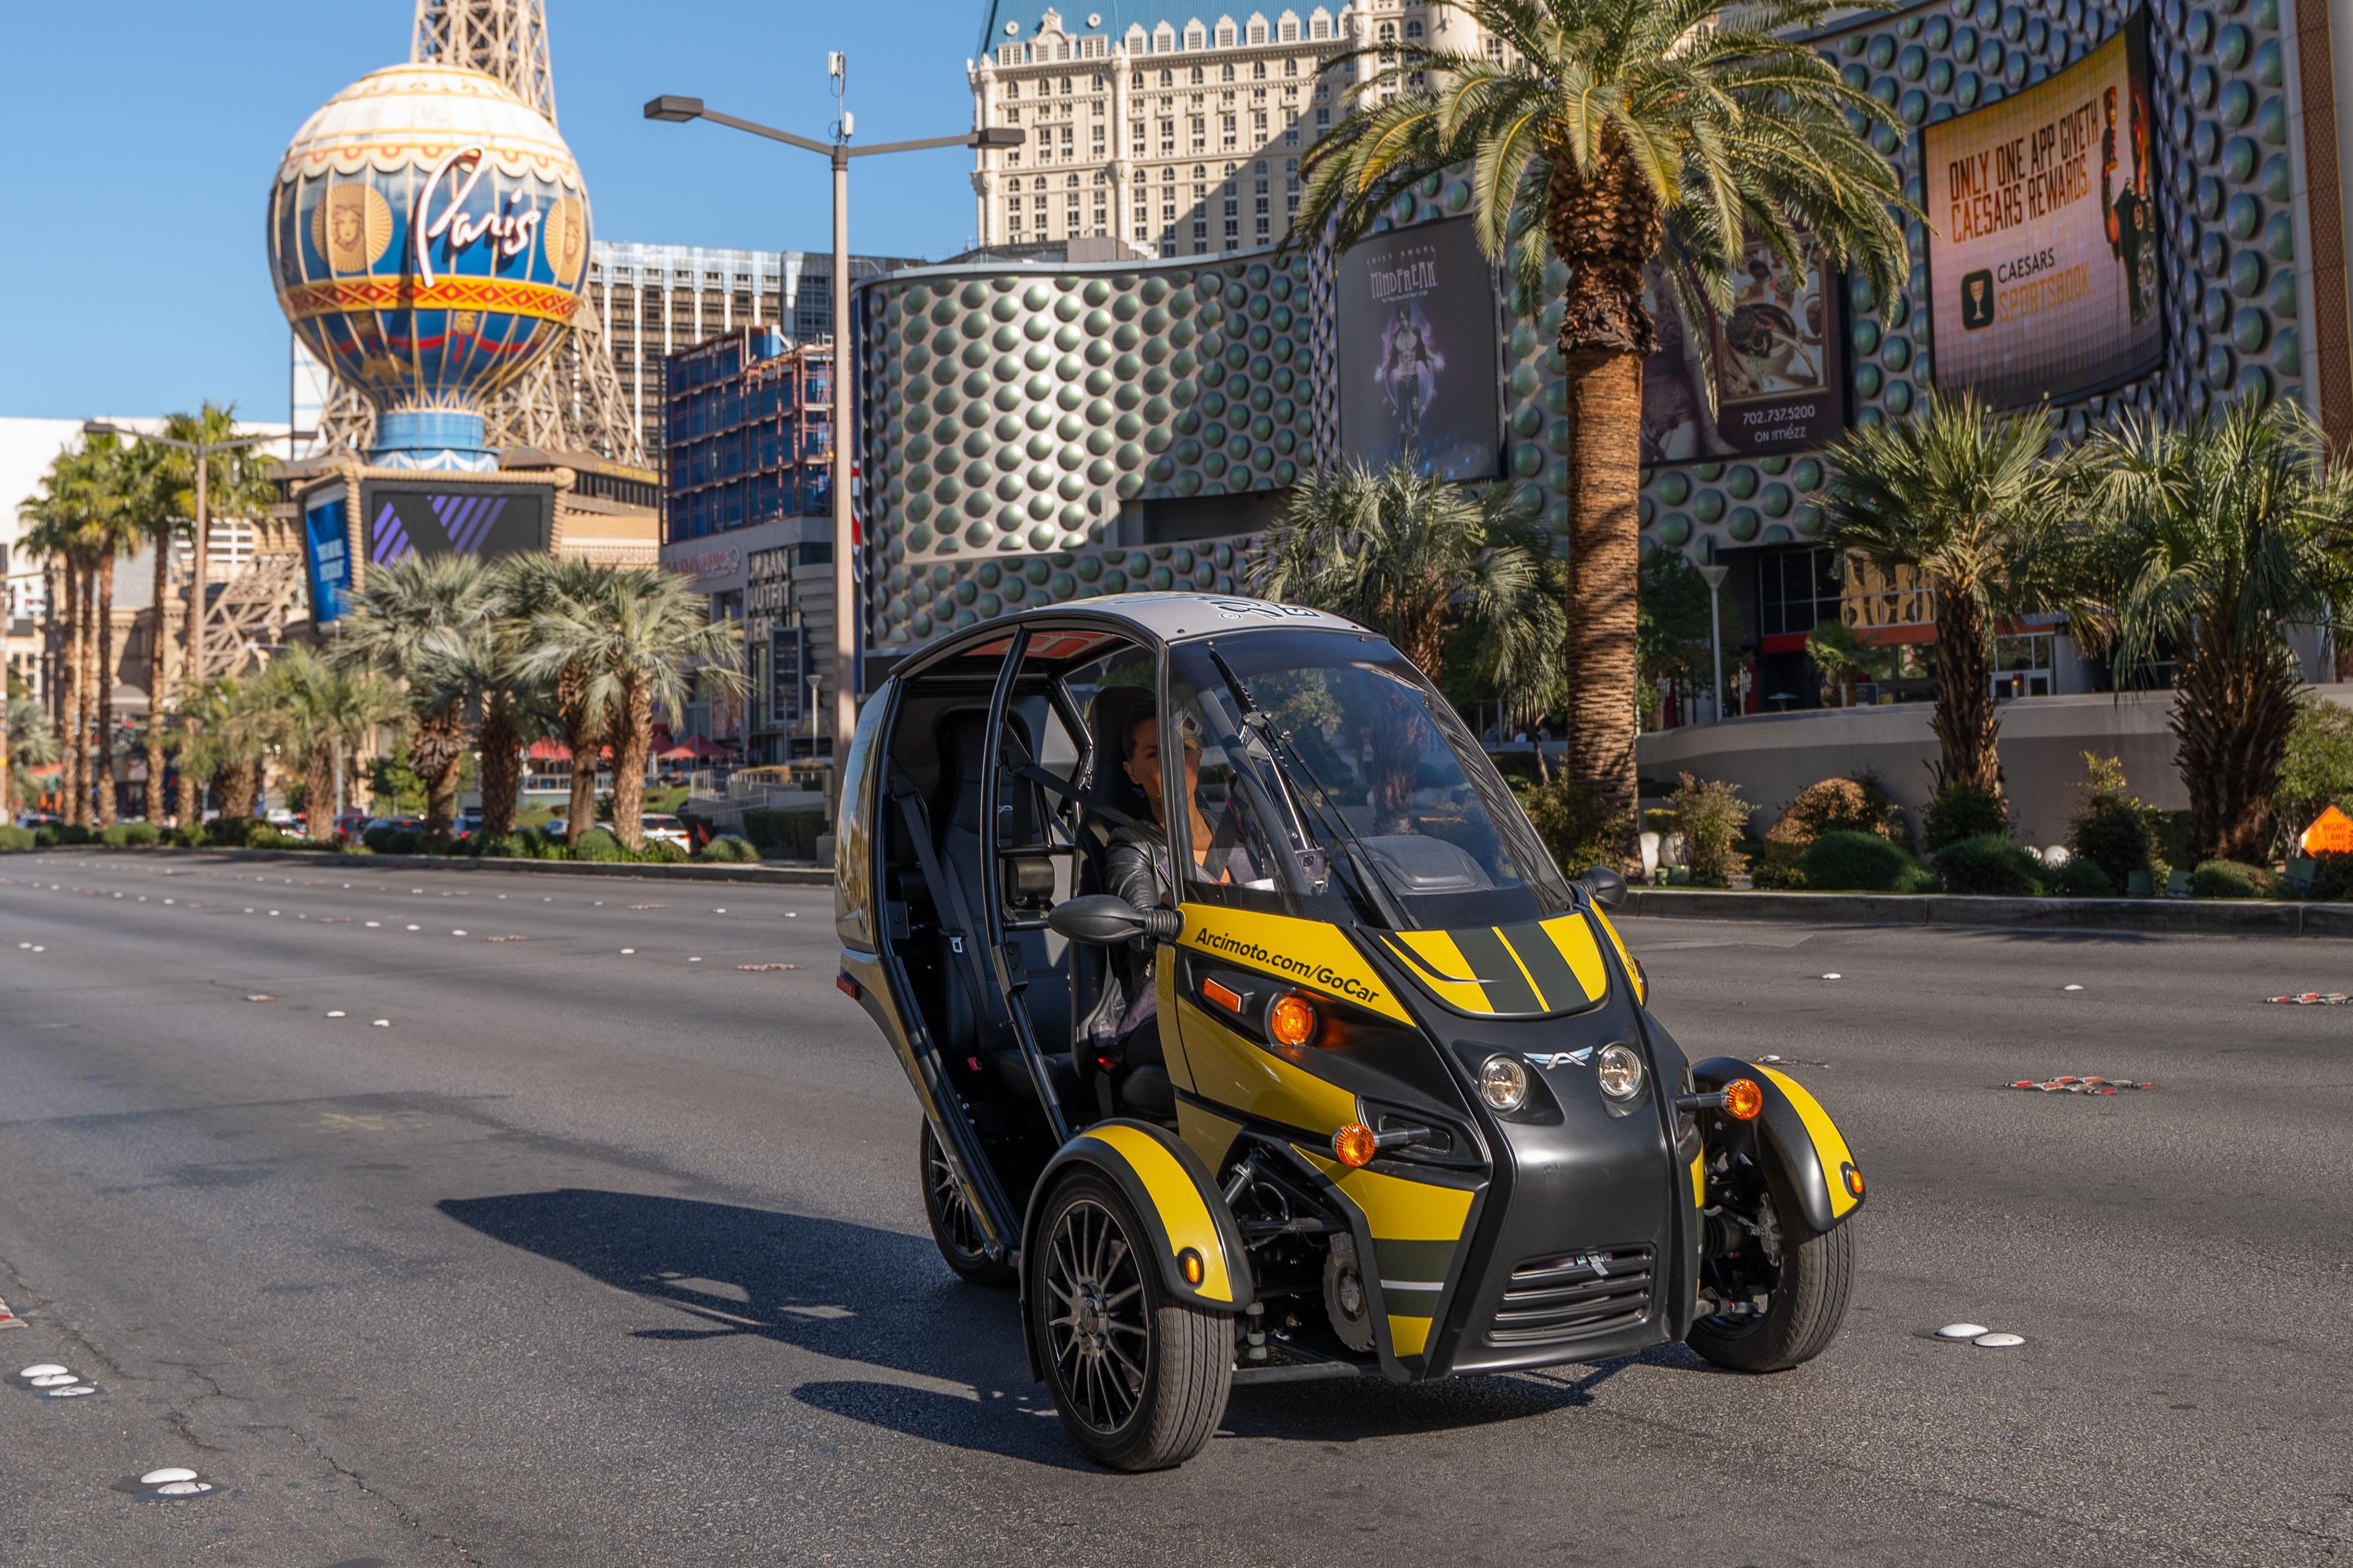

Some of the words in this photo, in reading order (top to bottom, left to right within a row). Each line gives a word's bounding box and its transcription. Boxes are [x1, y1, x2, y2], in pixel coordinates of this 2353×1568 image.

[1949, 151, 1989, 202] ONLY
[1996, 138, 2025, 187] ONE
[2031, 122, 2056, 170] APP
[2060, 98, 2098, 161] GIVETH
[415, 142, 542, 288] Paris
[1951, 187, 2023, 243] CAESARS
[1370, 261, 1436, 300] MINDFREAK
[1997, 248, 2056, 283] CAESARS
[1998, 262, 2089, 323] SPORTSBOOK
[1743, 405, 1815, 425] 702.737.5200
[1755, 431, 1769, 443] ON
[1194, 927, 1380, 1003] Arcimoto.com/GoCar
